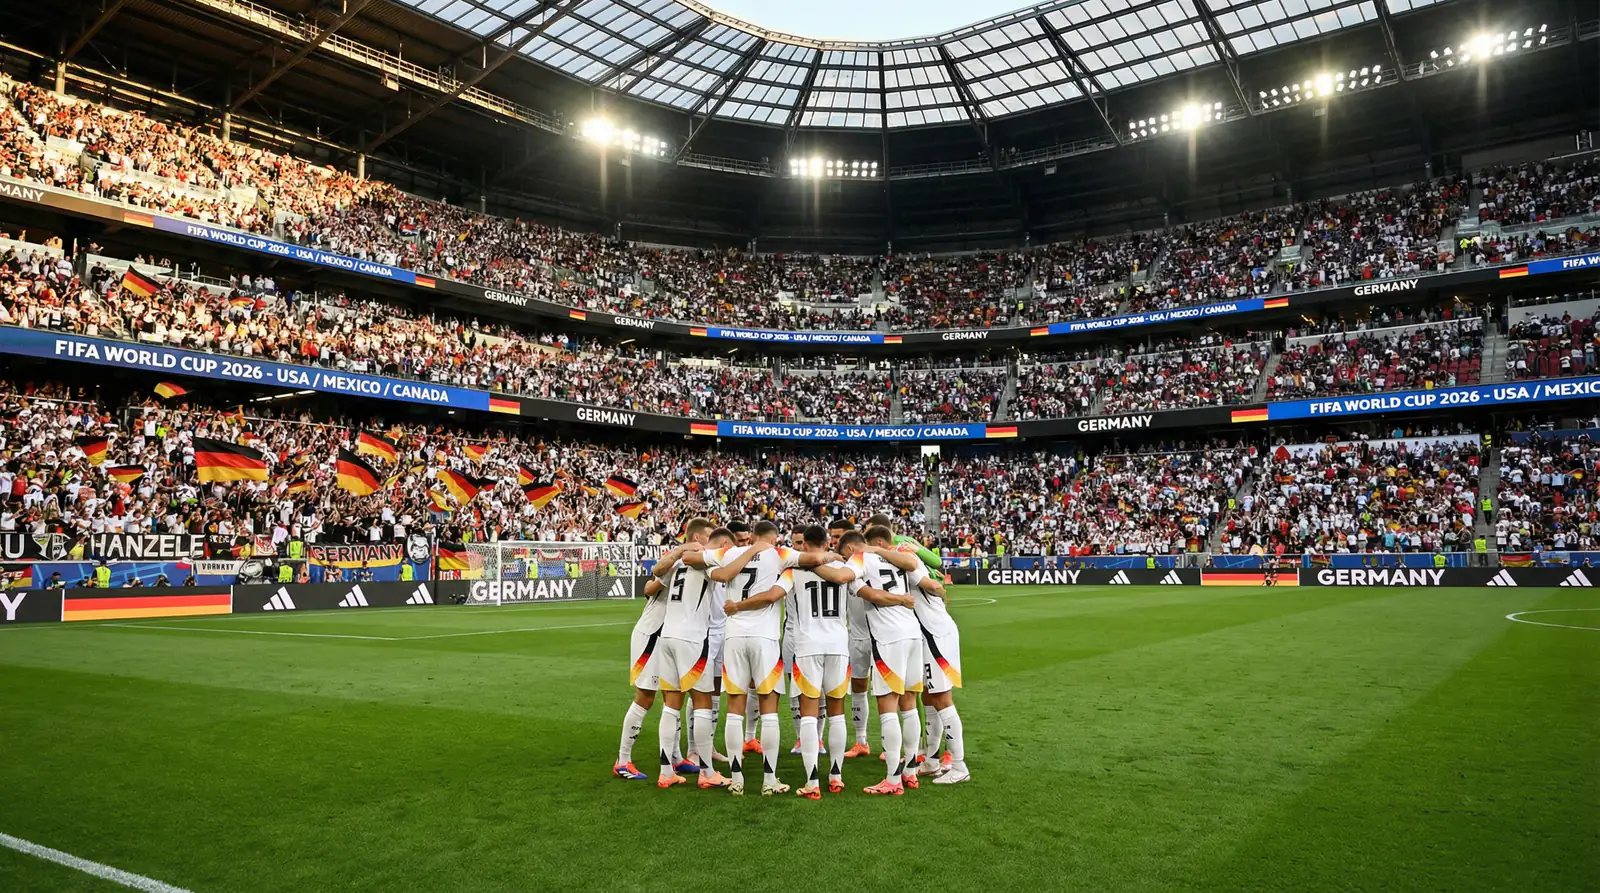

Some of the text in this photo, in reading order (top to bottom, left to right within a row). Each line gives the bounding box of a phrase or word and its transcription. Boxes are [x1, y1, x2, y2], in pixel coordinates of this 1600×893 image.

[0, 182, 45, 201] MANY
[187, 225, 209, 237] FIFA
[210, 229, 246, 245] WORLD
[247, 238, 267, 249] CUP
[268, 243, 290, 255] 2026
[296, 249, 314, 260] USA
[321, 254, 353, 268] MEXICO
[359, 263, 393, 276] CANADA
[1563, 255, 1600, 268] FIFA W
[1353, 279, 1419, 296] GERMANY
[484, 290, 528, 307] GERMANY
[1205, 304, 1237, 314] CANADA
[614, 316, 655, 330] GERMANY
[942, 331, 989, 341] GERMANY
[55, 340, 101, 360] FIFA
[103, 346, 177, 369] WORLD
[180, 356, 218, 373] CUP
[221, 361, 263, 379] 2026
[276, 369, 310, 386] USA
[312, 373, 321, 388] /
[323, 375, 381, 395] MEXICO
[383, 382, 391, 397] /
[392, 384, 449, 402] CANADA
[1310, 401, 1343, 414] FIFA
[1345, 397, 1401, 412] WORLD
[1403, 394, 1437, 408] CUP
[1439, 390, 1480, 405] 2026
[1493, 386, 1531, 400] USA
[1533, 385, 1542, 399] /
[1544, 380, 1600, 396] MEXIC
[576, 407, 637, 426] GERMANY
[1077, 414, 1154, 432] GERMANY
[732, 425, 754, 435] FIFA
[755, 426, 791, 437] WORLD
[792, 427, 813, 437] CUP
[814, 428, 839, 438] 2026
[846, 428, 868, 438] USA
[875, 427, 915, 438] MEXICO
[923, 427, 969, 437] CANADA
[312, 544, 403, 562] GERMANY
[671, 567, 688, 602] 5
[740, 567, 758, 602] 7
[988, 569, 1081, 585] GERMANY
[1317, 568, 1446, 587] GERMANY
[472, 579, 577, 601] GERMANY
[804, 580, 841, 617] 10
[0, 592, 27, 620] Y
